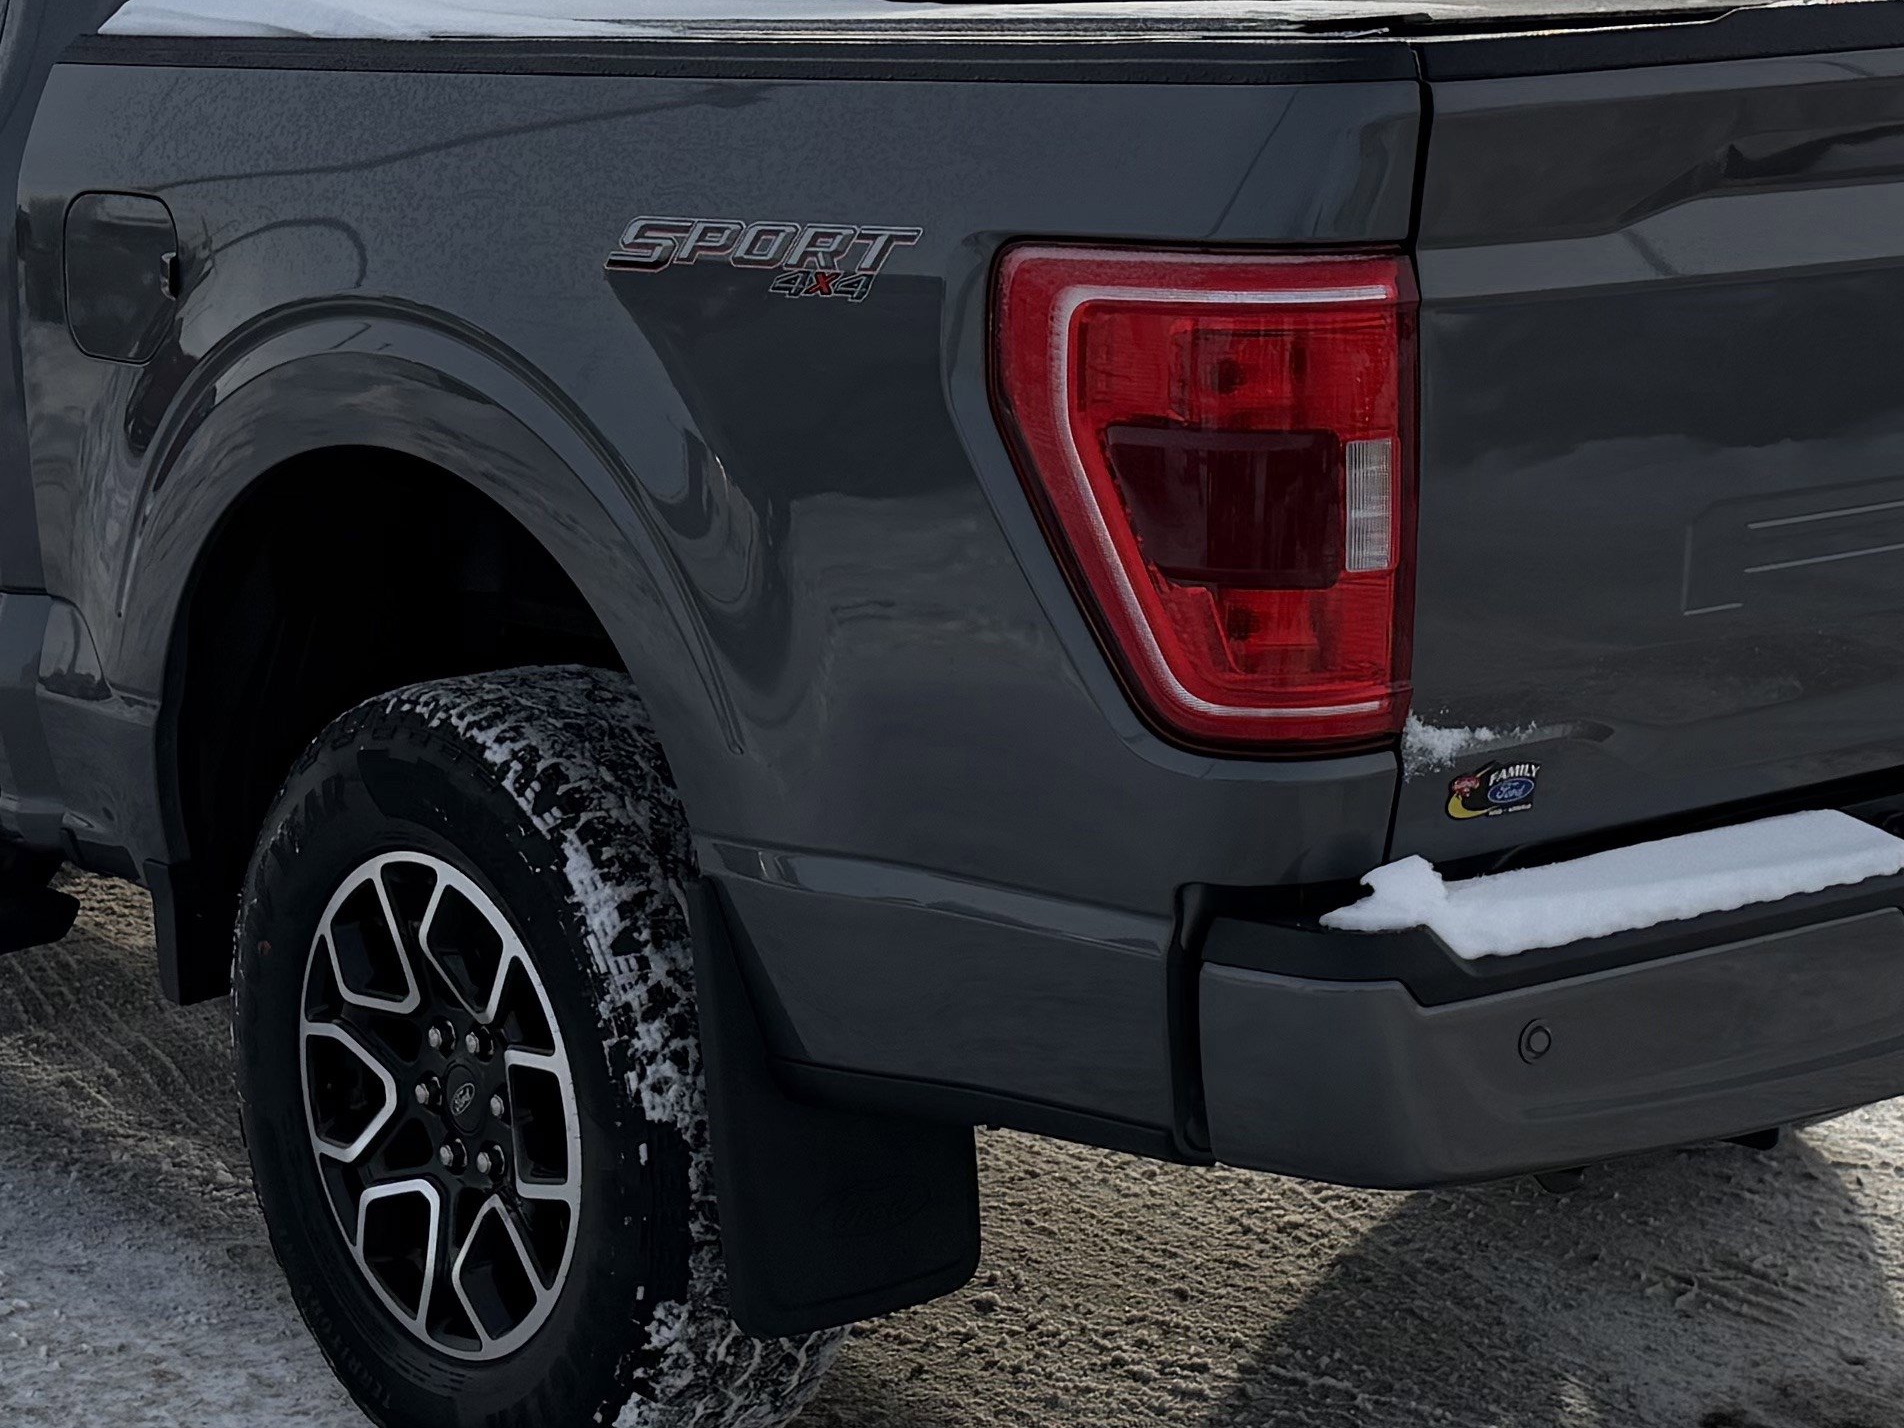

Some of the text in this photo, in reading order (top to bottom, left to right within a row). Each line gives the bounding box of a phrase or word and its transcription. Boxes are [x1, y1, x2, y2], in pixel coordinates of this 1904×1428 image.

[603, 215, 924, 273] SPORT
[1488, 763, 1540, 787] FAMILY
[1496, 781, 1526, 800] Ford
